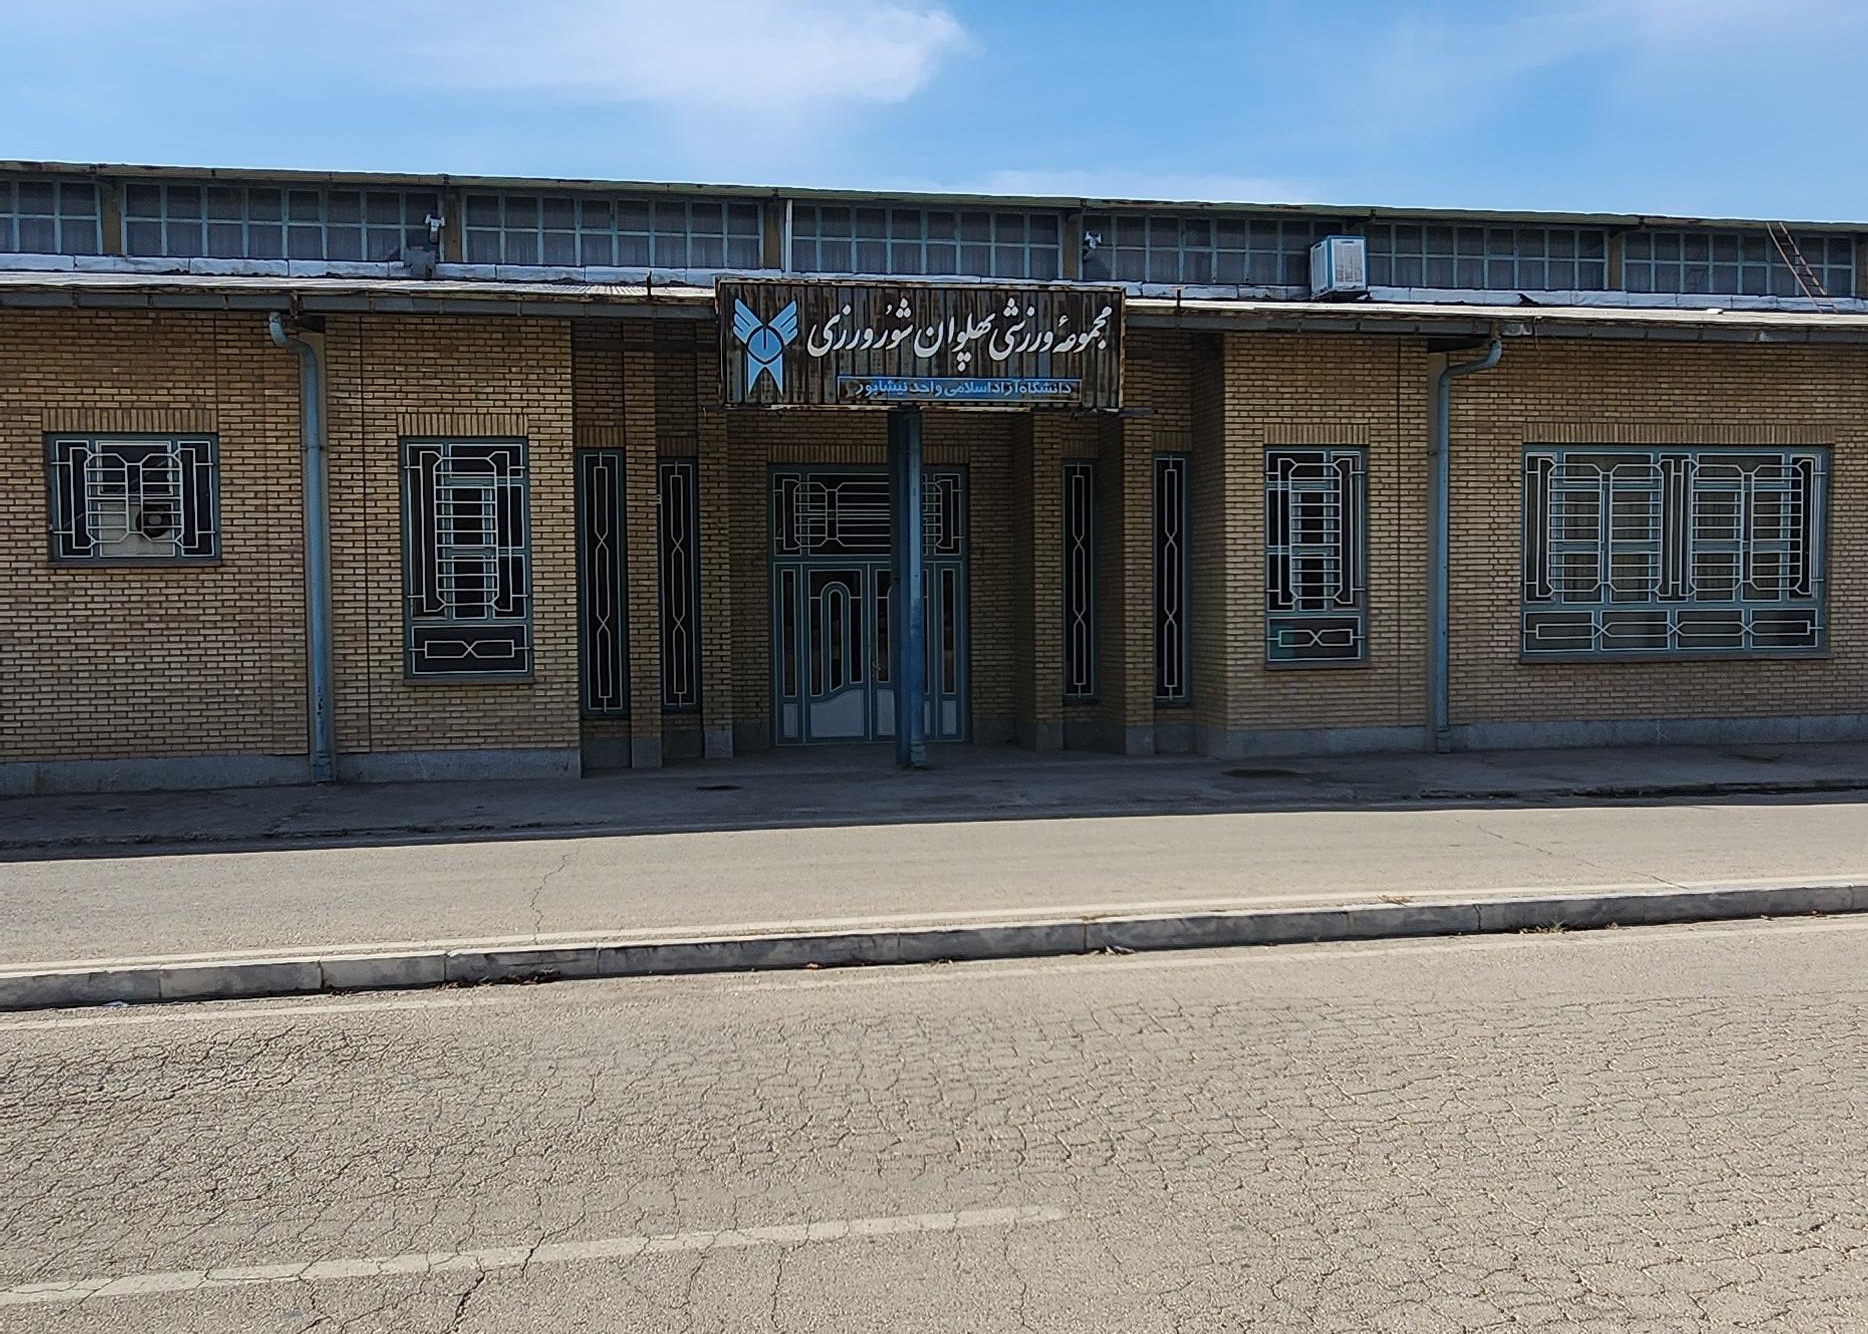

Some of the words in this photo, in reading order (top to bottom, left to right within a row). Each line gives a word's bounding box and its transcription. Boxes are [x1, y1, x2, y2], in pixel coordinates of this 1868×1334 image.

[988, 297, 1054, 361] ورزشی
[914, 313, 996, 372] پهلوان
[855, 379, 908, 397] نیشابور
[909, 380, 943, 397] واحد
[943, 380, 991, 397] اسلامی
[992, 378, 1020, 396] آزاد
[1019, 381, 1072, 394] دانشگاه
